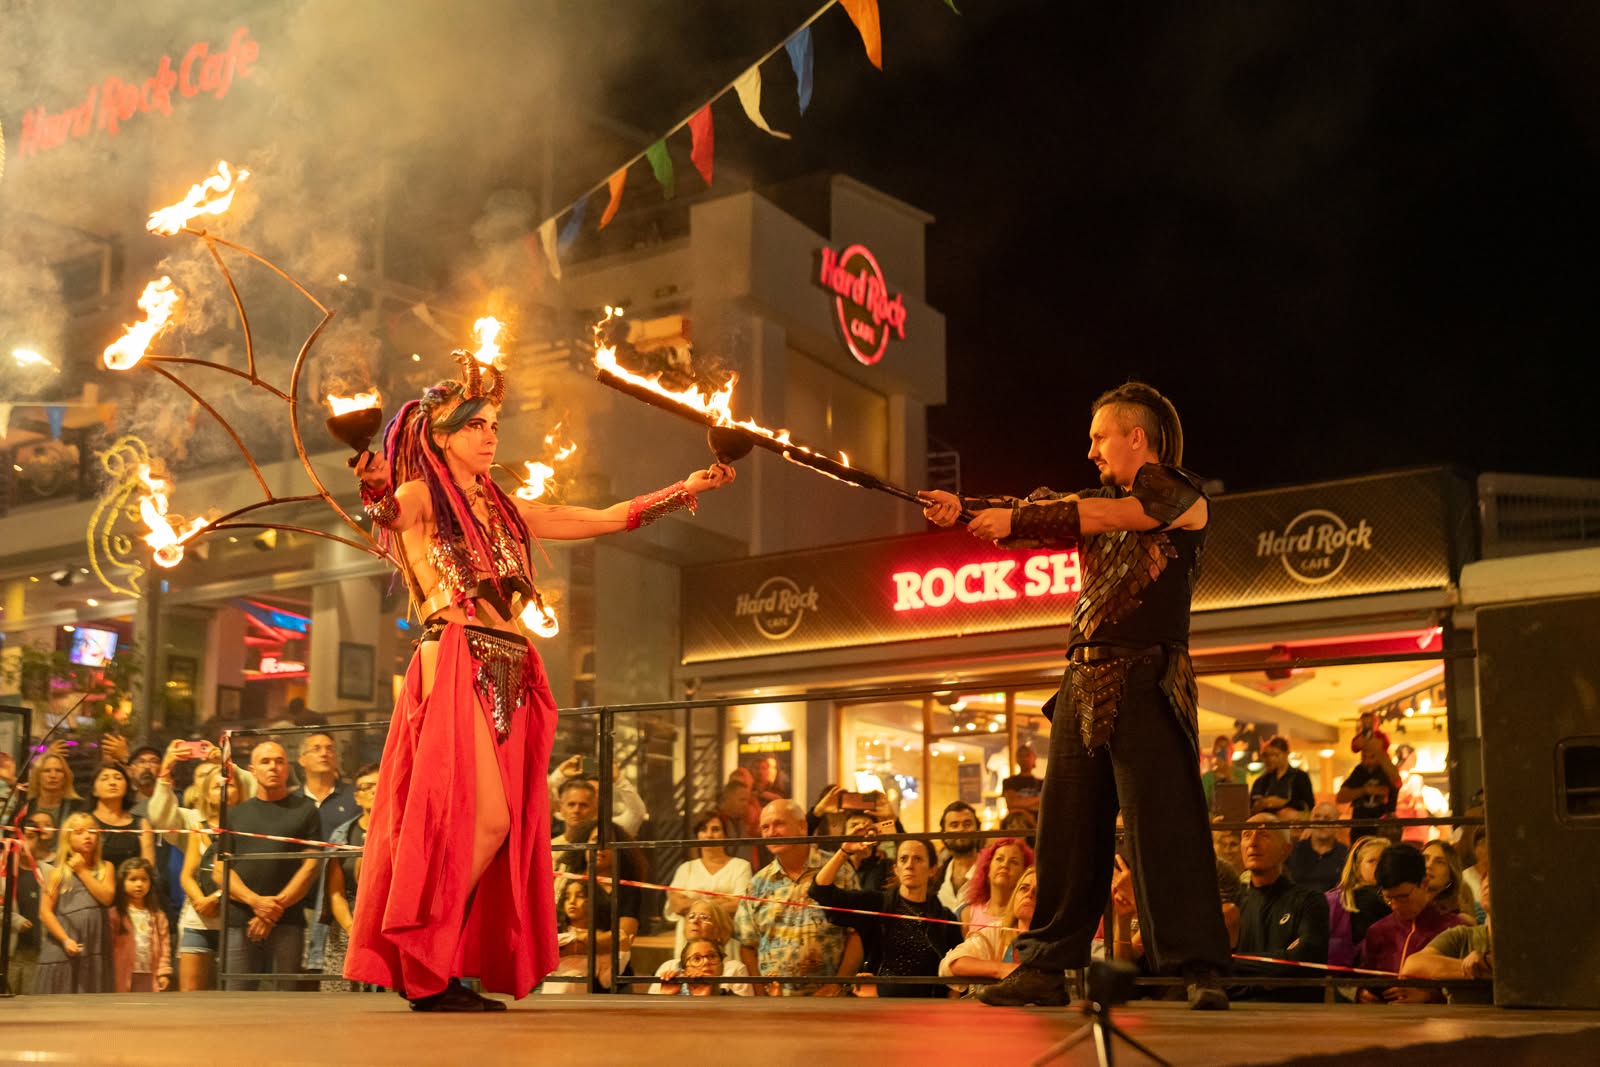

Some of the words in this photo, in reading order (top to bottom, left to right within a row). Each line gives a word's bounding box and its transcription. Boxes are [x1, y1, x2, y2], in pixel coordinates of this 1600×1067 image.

[19, 85, 97, 157] Hard
[98, 55, 177, 135] Rock
[179, 26, 259, 99] Cafe
[821, 247, 868, 306] Hard
[866, 275, 907, 340] Rock
[1257, 525, 1315, 557] Hard
[1316, 519, 1373, 554] Rock
[893, 559, 1017, 611] ROCK
[1024, 552, 1081, 597] SH
[1301, 556, 1331, 569] CAFE
[735, 590, 777, 616] Hard
[777, 586, 819, 614] Rock
